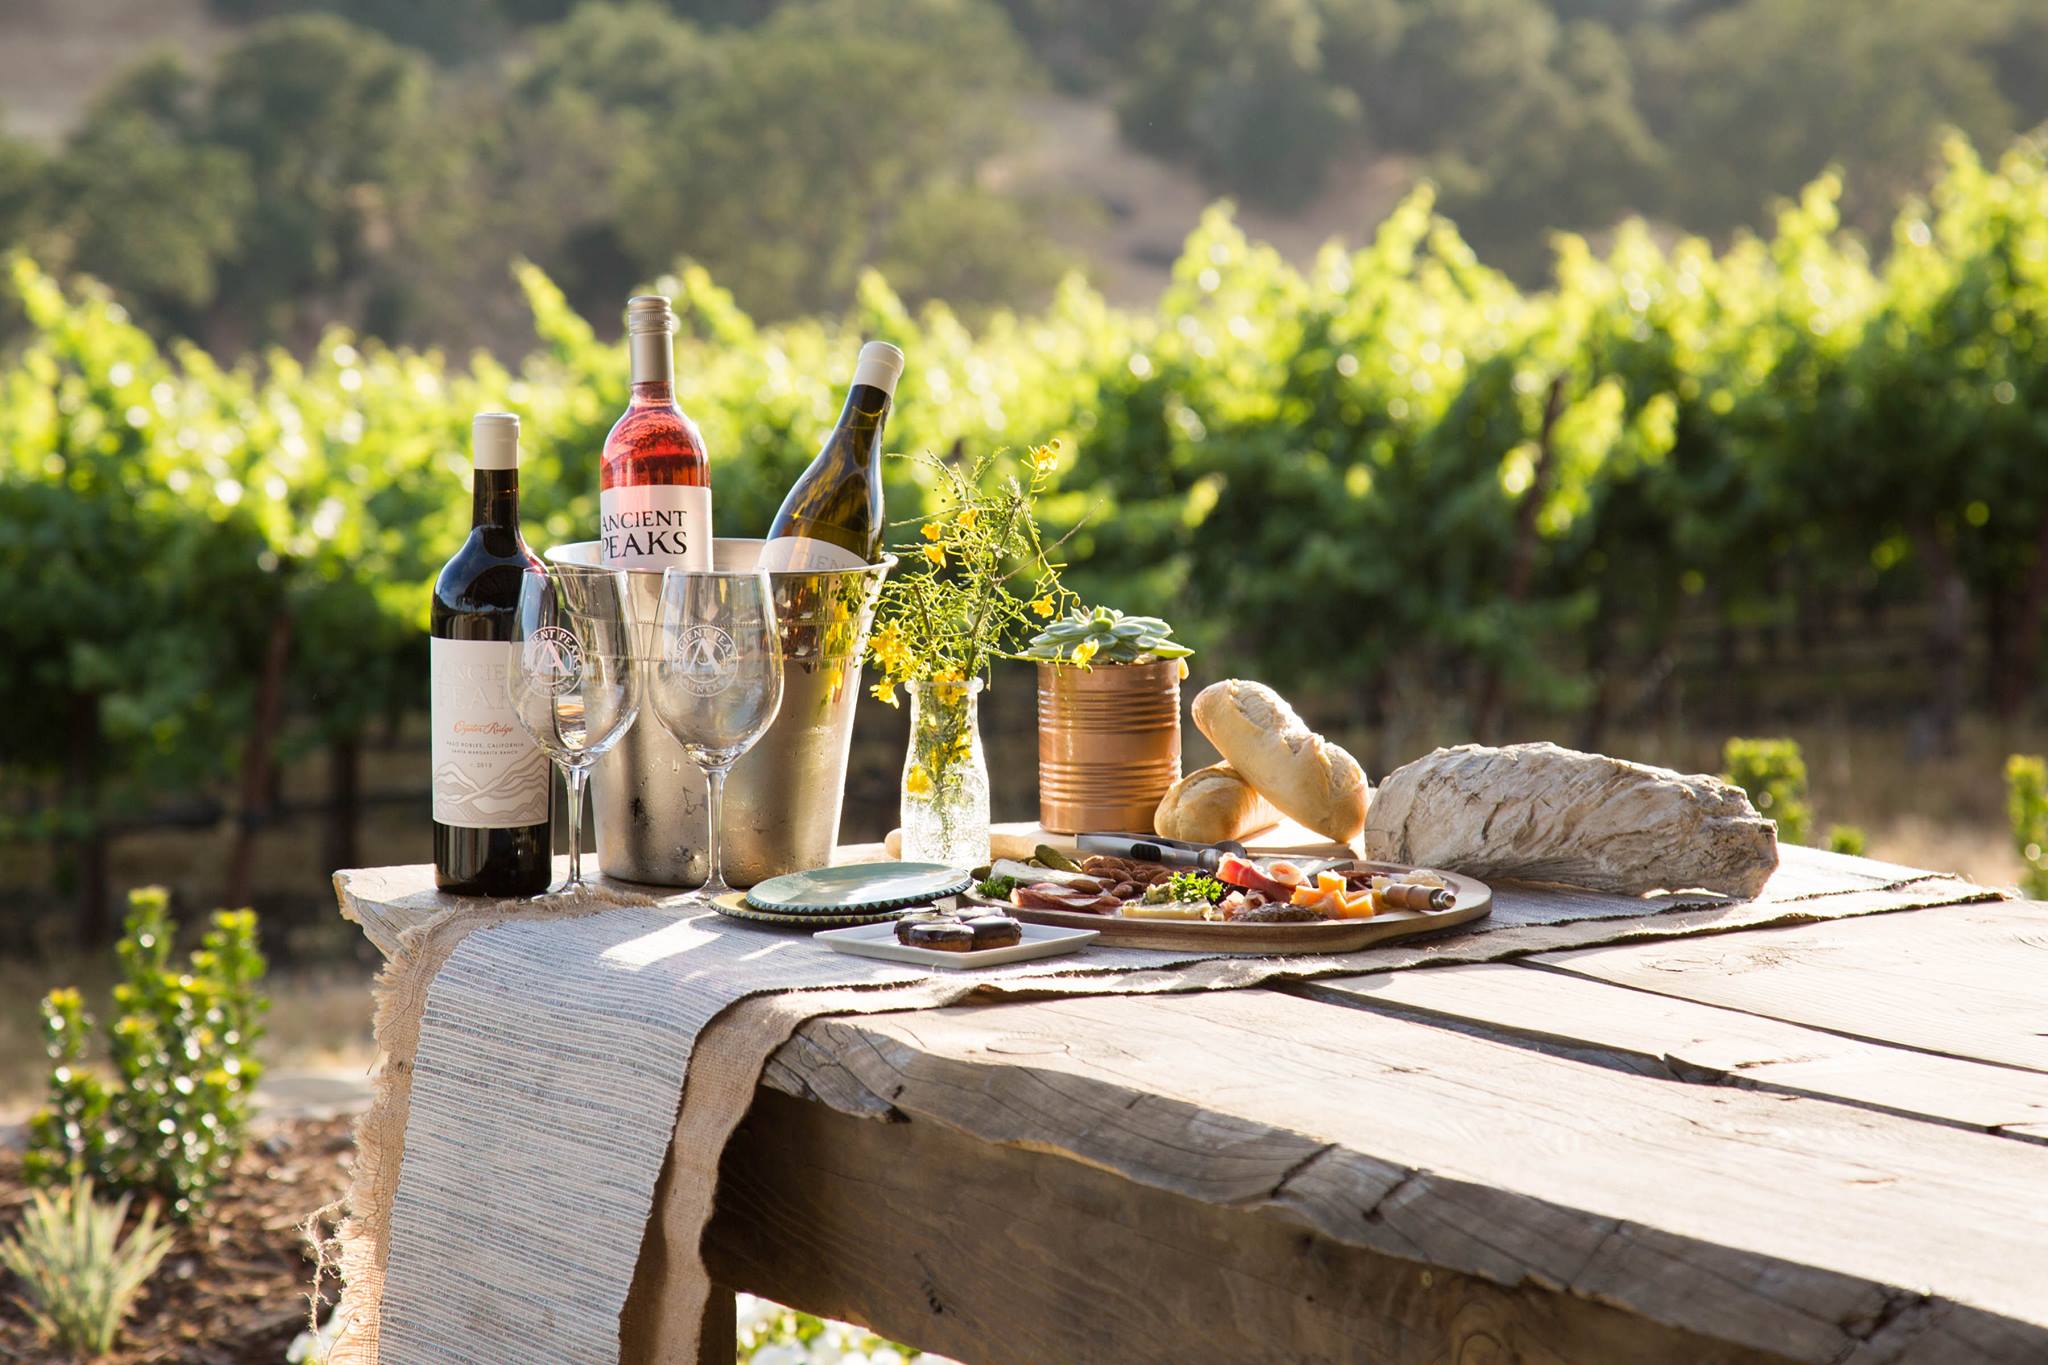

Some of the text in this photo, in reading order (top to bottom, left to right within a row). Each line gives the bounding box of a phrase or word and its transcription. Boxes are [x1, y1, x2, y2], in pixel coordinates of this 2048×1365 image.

[603, 511, 687, 532] ANCIENT
[602, 531, 687, 560] PEAKS
[439, 661, 505, 681] ANCIE
[481, 721, 514, 737] Ridge
